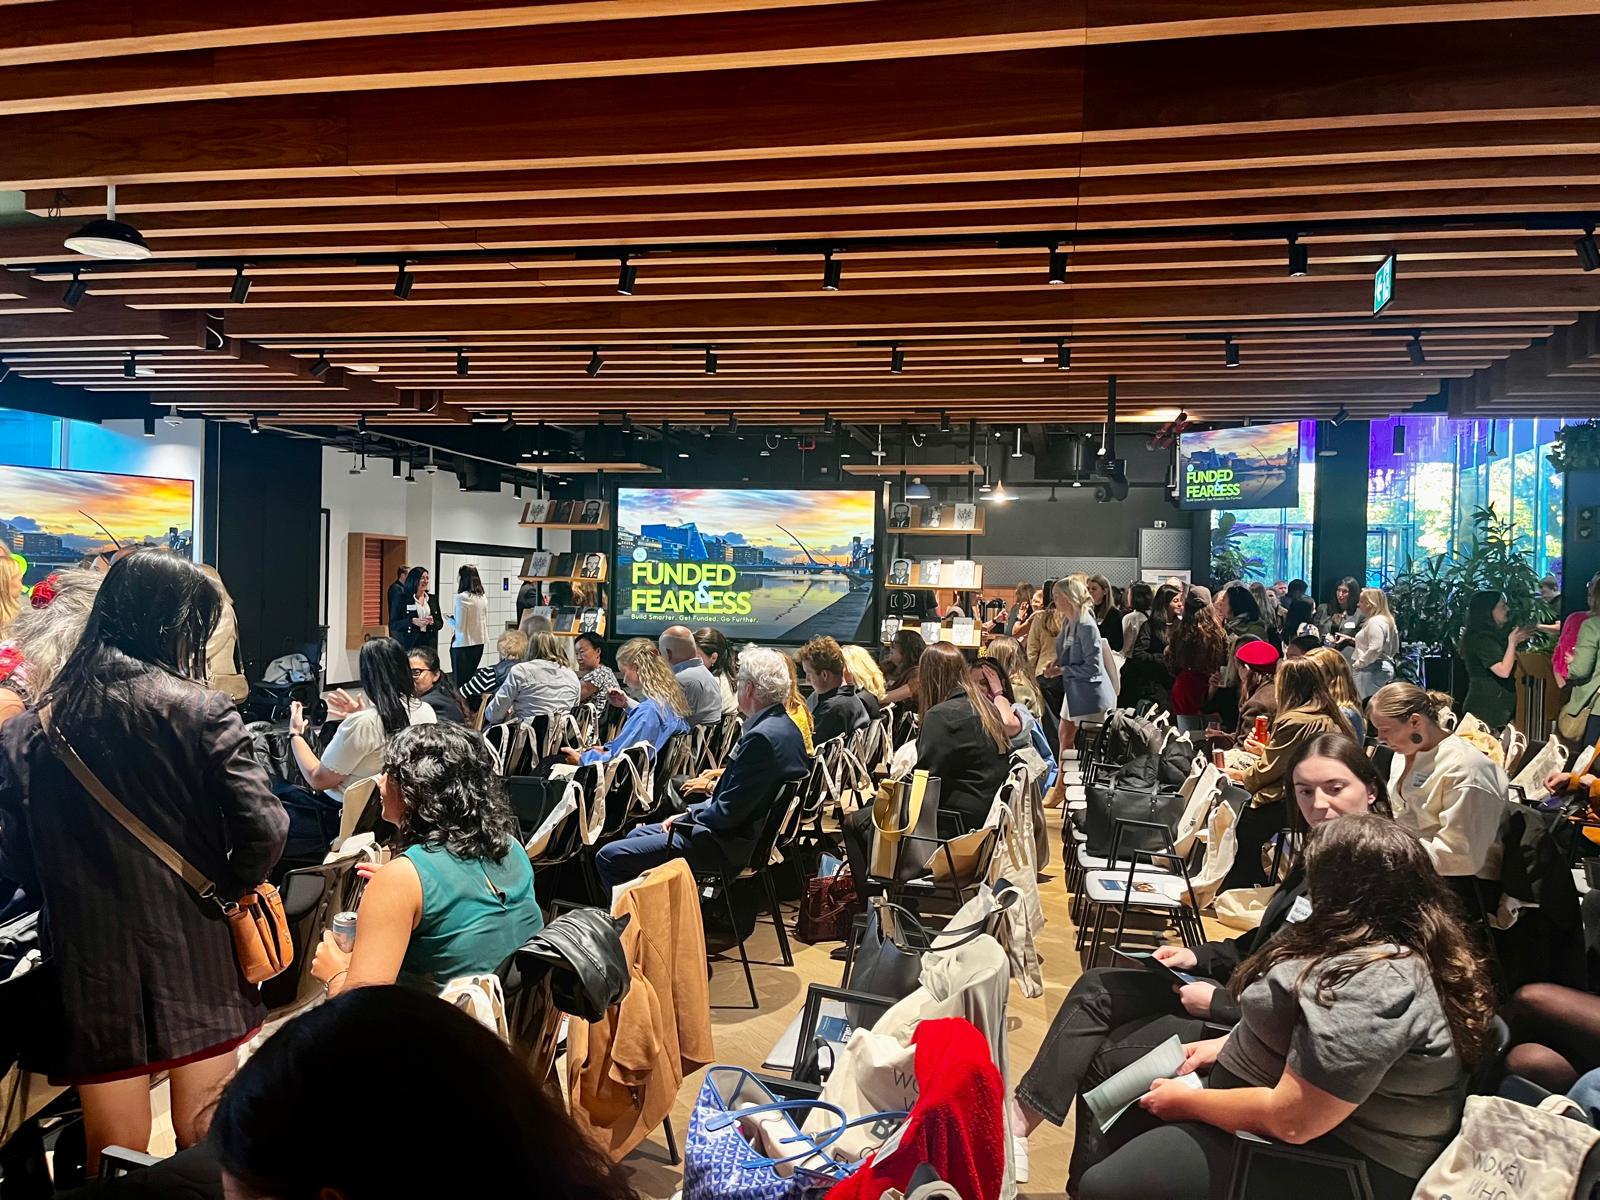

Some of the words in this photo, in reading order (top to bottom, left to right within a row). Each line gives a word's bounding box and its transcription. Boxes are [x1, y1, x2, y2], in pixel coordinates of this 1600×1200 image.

[1186, 469, 1233, 484] FUNDED
[1186, 483, 1240, 498] FEARLESS
[632, 562, 737, 586] FUNDED
[631, 589, 752, 615] FEARLESS
[696, 580, 715, 603] &
[1472, 1150, 1527, 1189] WOMEN
